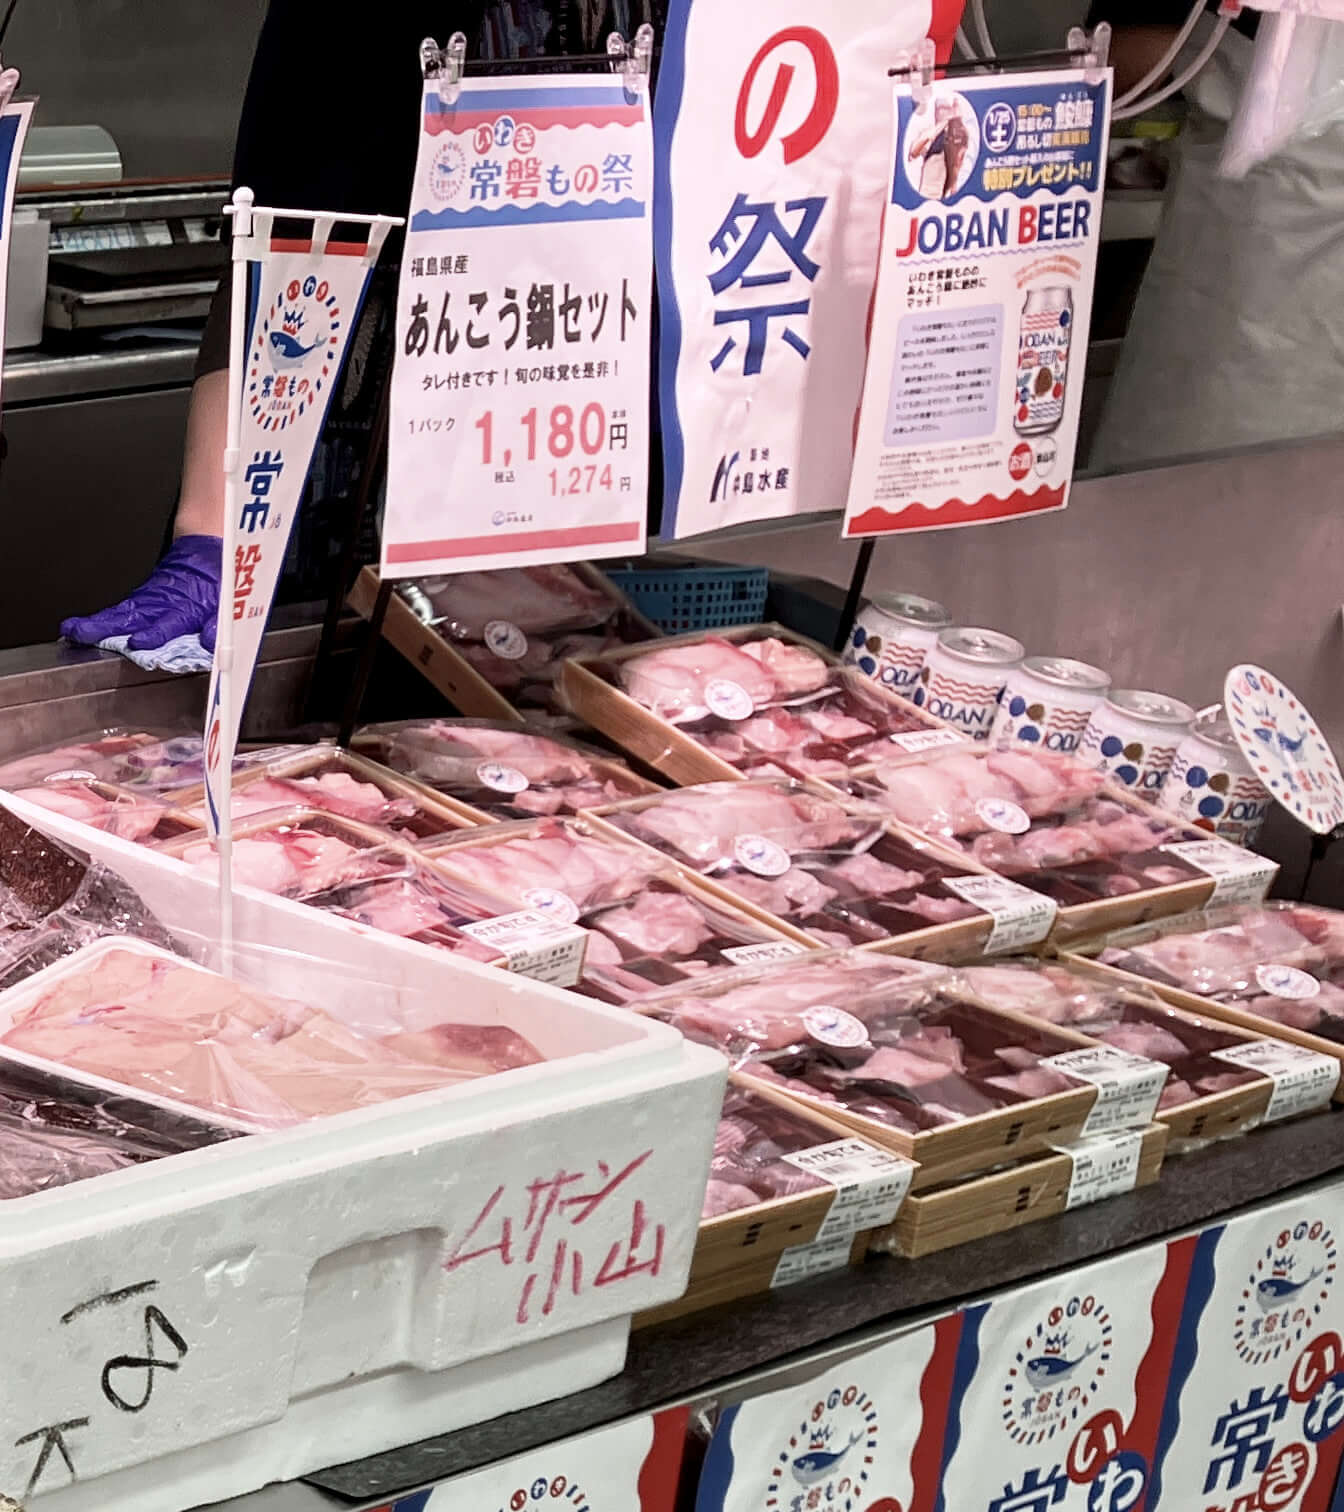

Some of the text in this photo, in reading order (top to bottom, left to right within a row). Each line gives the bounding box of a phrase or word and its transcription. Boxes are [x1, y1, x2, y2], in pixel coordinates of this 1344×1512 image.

[469, 153, 634, 200] 常磐もの祭
[896, 199, 1091, 258] JOBAN BEER
[404, 278, 638, 358] あんこう鍋セット
[548, 463, 613, 497] 1,274
